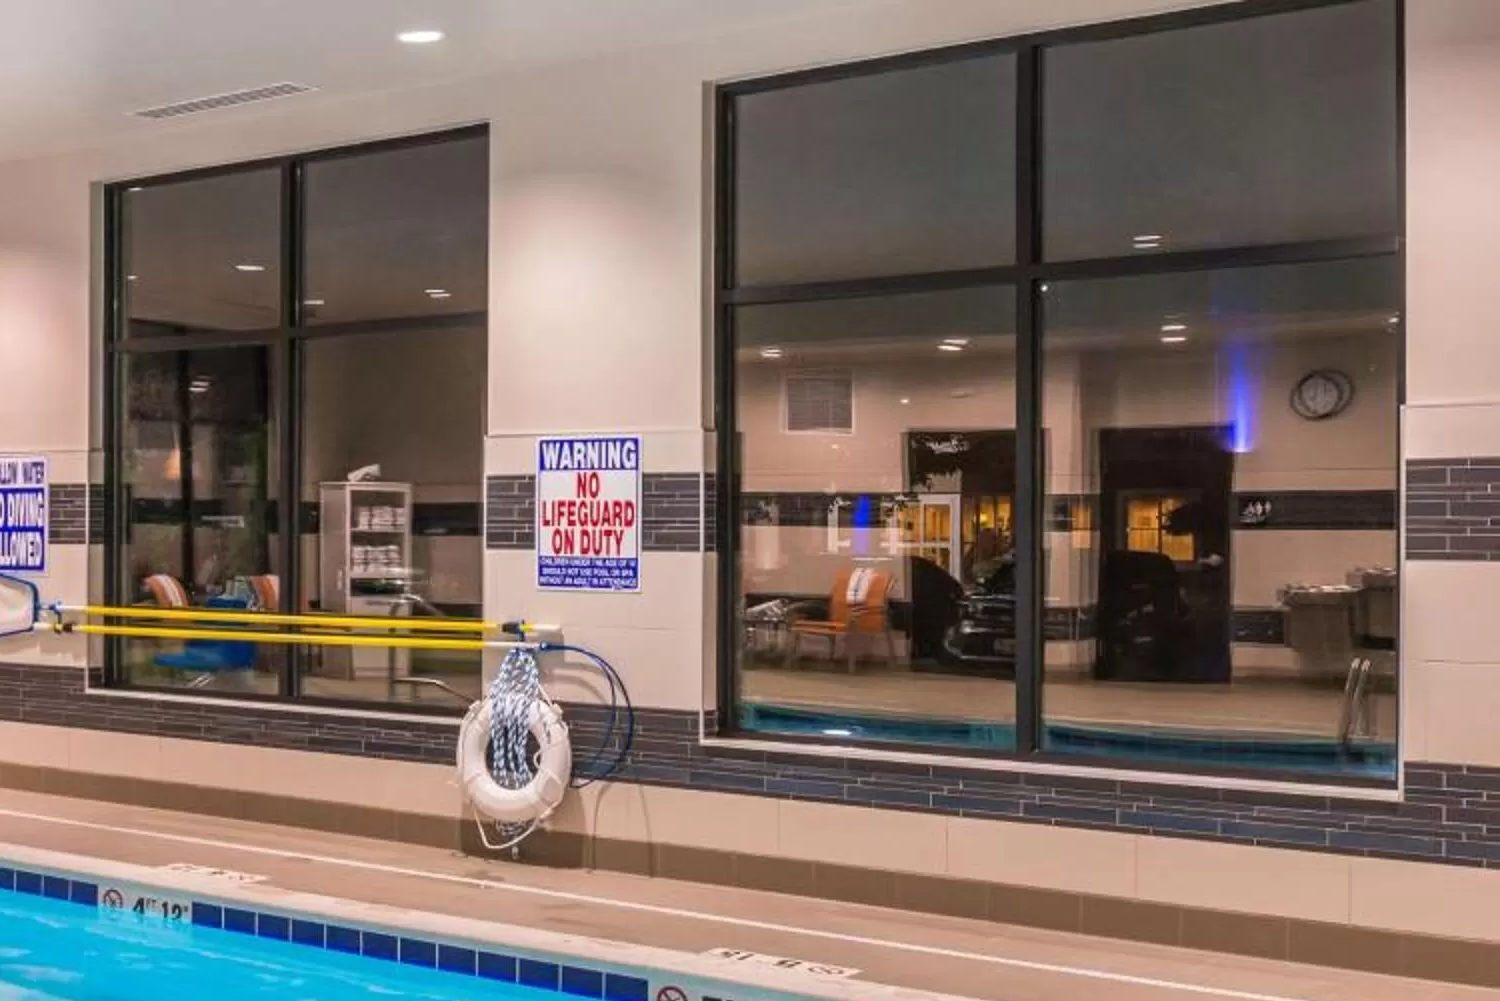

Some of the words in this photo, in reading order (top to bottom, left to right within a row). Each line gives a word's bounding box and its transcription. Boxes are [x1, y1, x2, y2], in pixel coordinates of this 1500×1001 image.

[542, 440, 637, 469] WARNING
[577, 472, 600, 498] NO
[7, 491, 43, 527] DIVING
[542, 500, 635, 526] LIFEGUARD
[552, 528, 575, 554] ON
[580, 530, 624, 555] DUTY
[567, 568, 579, 576] NOT
[580, 568, 593, 576] USE
[593, 569, 610, 577] POOL
[621, 569, 634, 577] SPA
